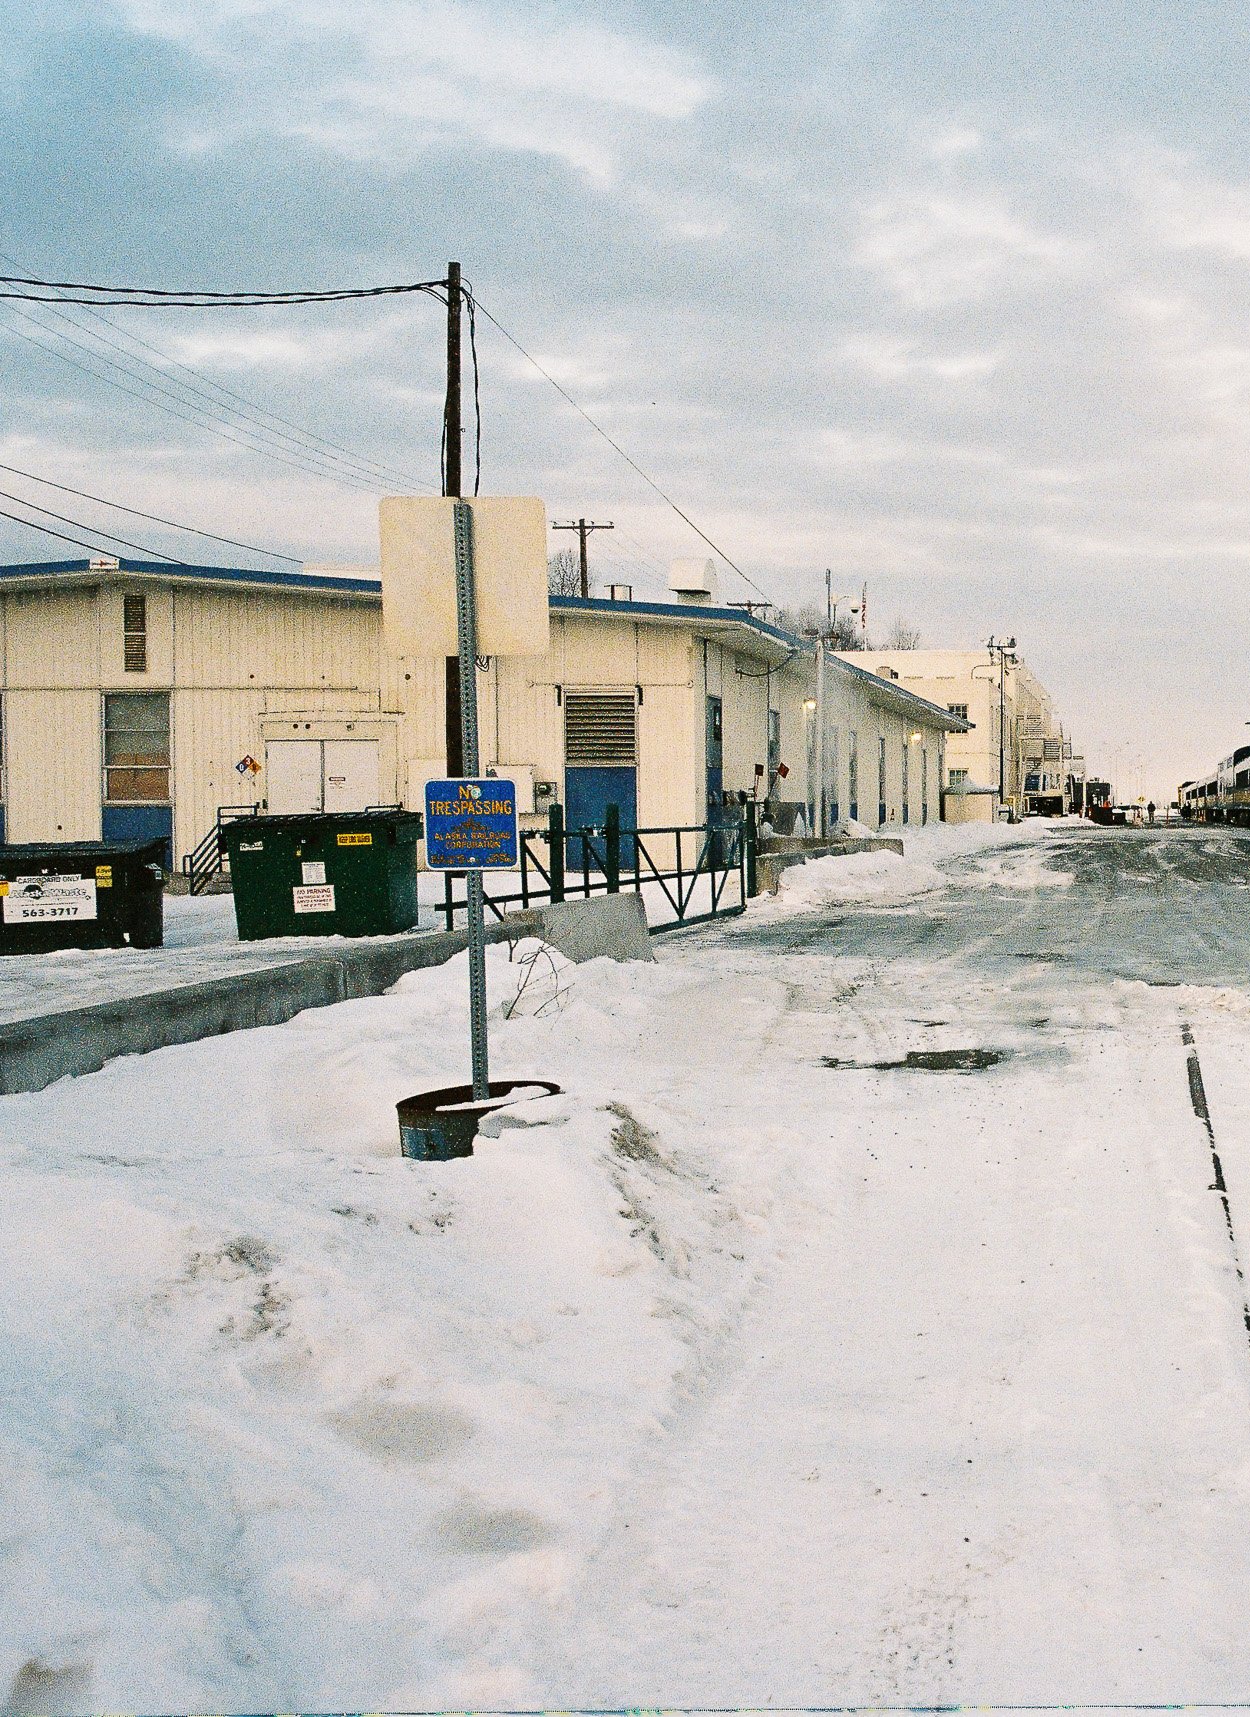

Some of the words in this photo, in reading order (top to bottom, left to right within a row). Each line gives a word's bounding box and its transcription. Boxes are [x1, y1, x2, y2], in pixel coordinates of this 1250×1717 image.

[459, 785, 481, 799] N
[430, 801, 512, 815] TRESPASSING
[434, 832, 467, 841] ALASKA
[445, 841, 501, 849] CORPORATION
[22, 907, 79, 917] 563-3717
